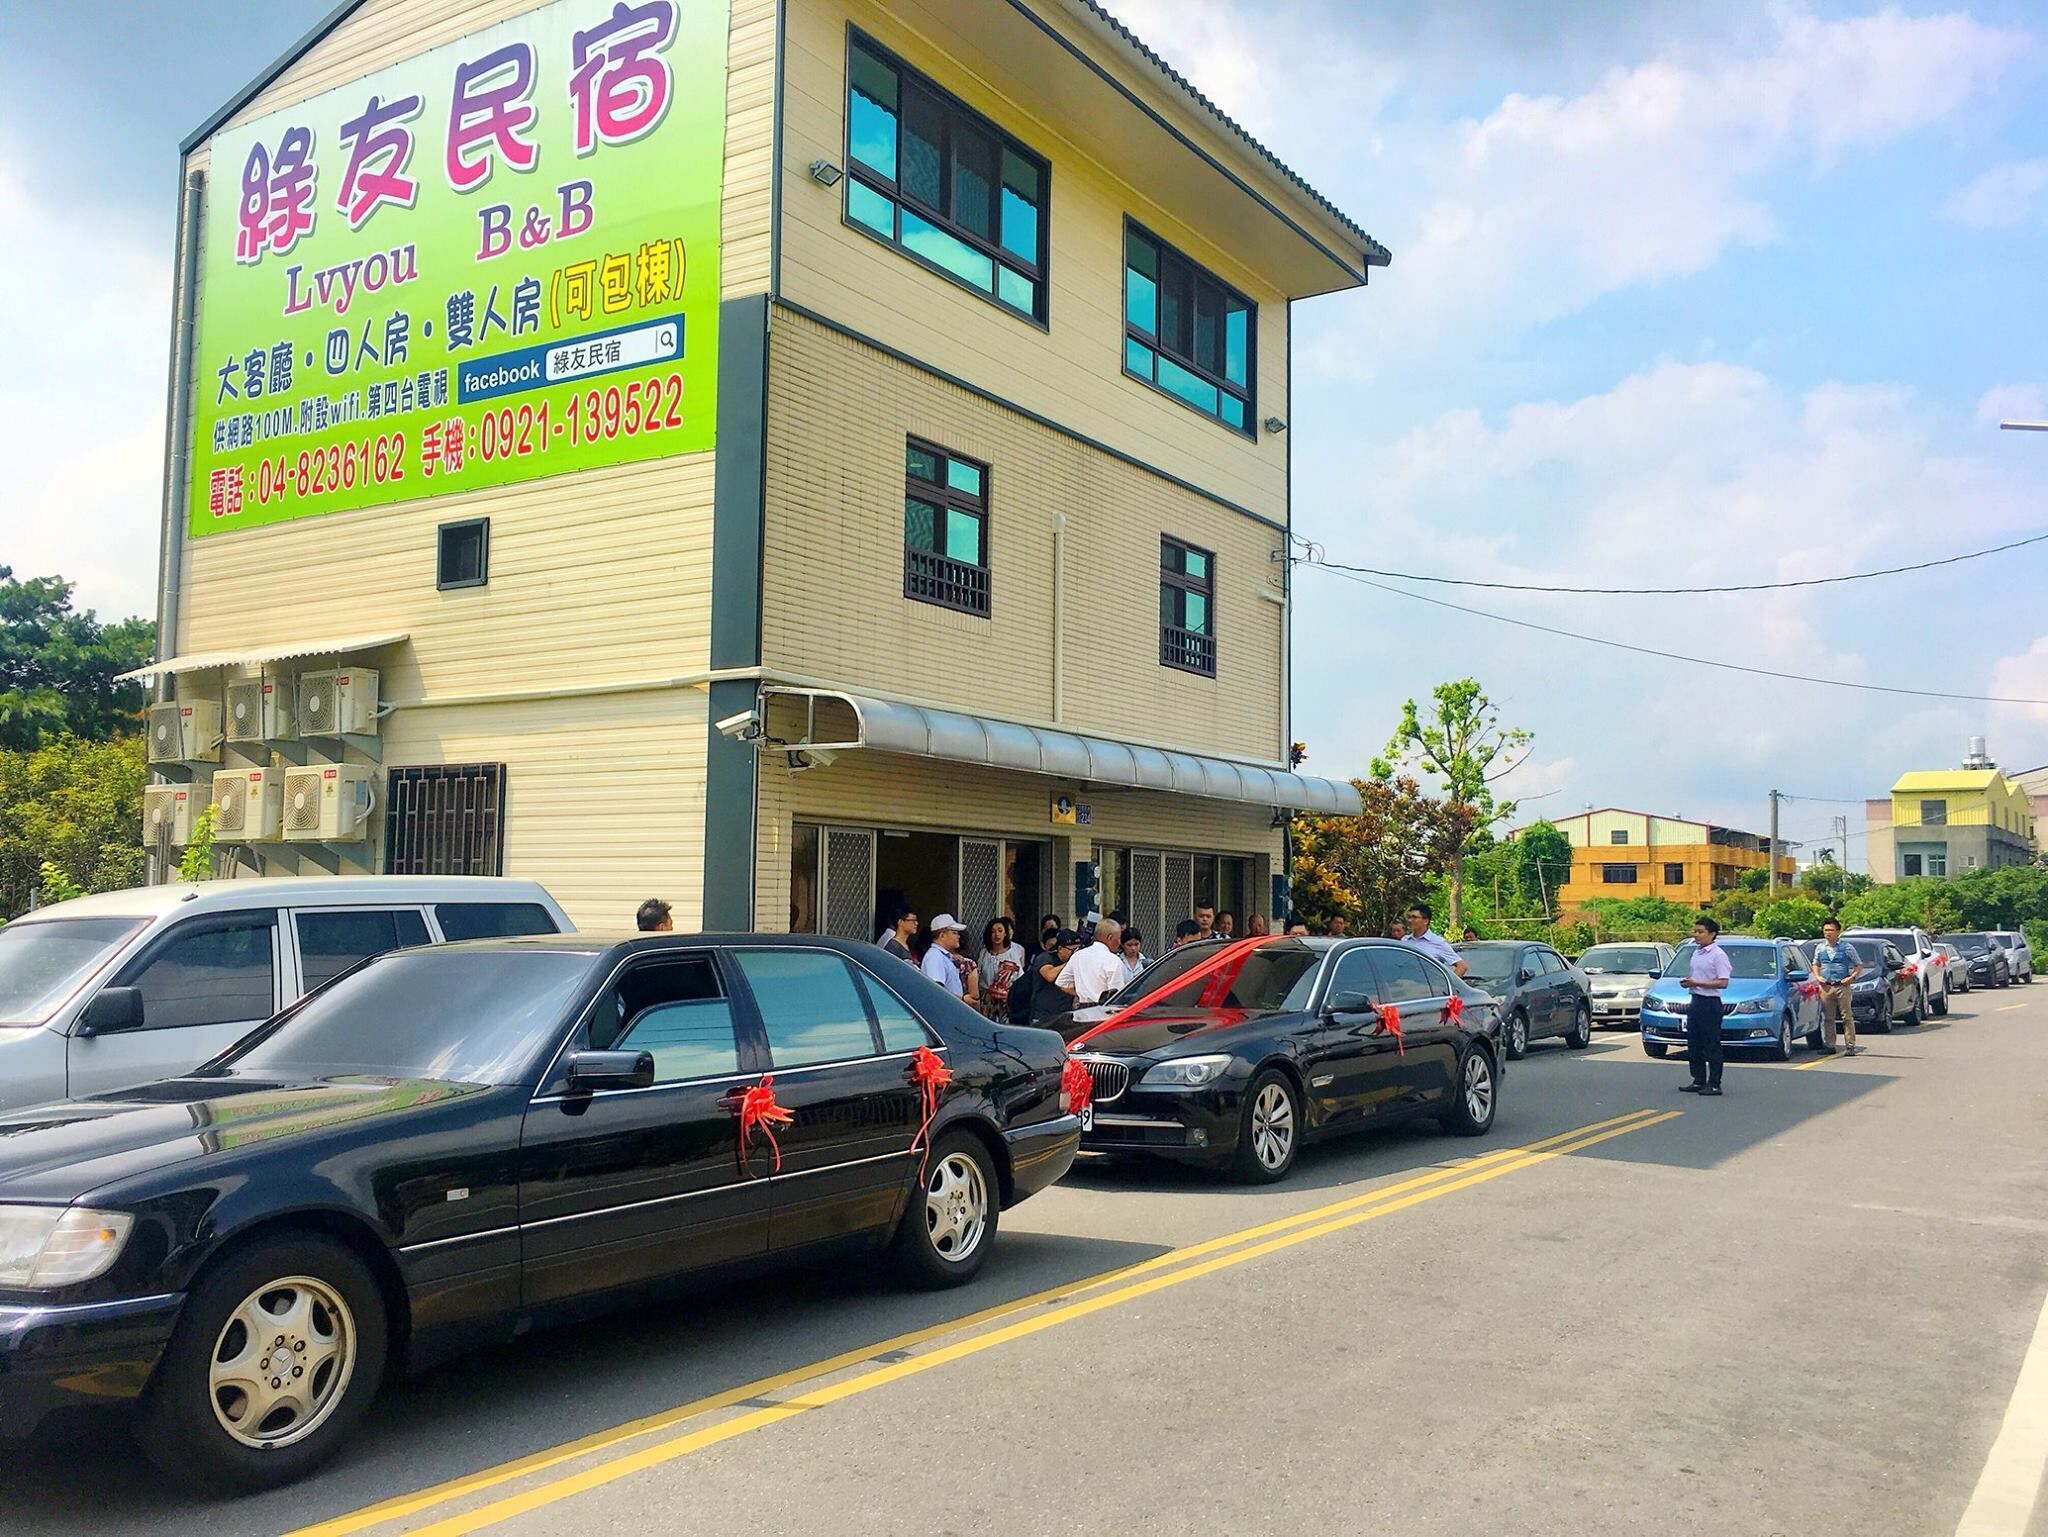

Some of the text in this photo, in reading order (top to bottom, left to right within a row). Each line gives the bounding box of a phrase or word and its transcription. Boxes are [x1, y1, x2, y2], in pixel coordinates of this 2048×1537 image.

[236, 0, 674, 258] 綠友民宿
[284, 180, 594, 315] Lvyou B&B
[464, 361, 540, 393] facebook
[553, 340, 622, 375] 綠友民宿
